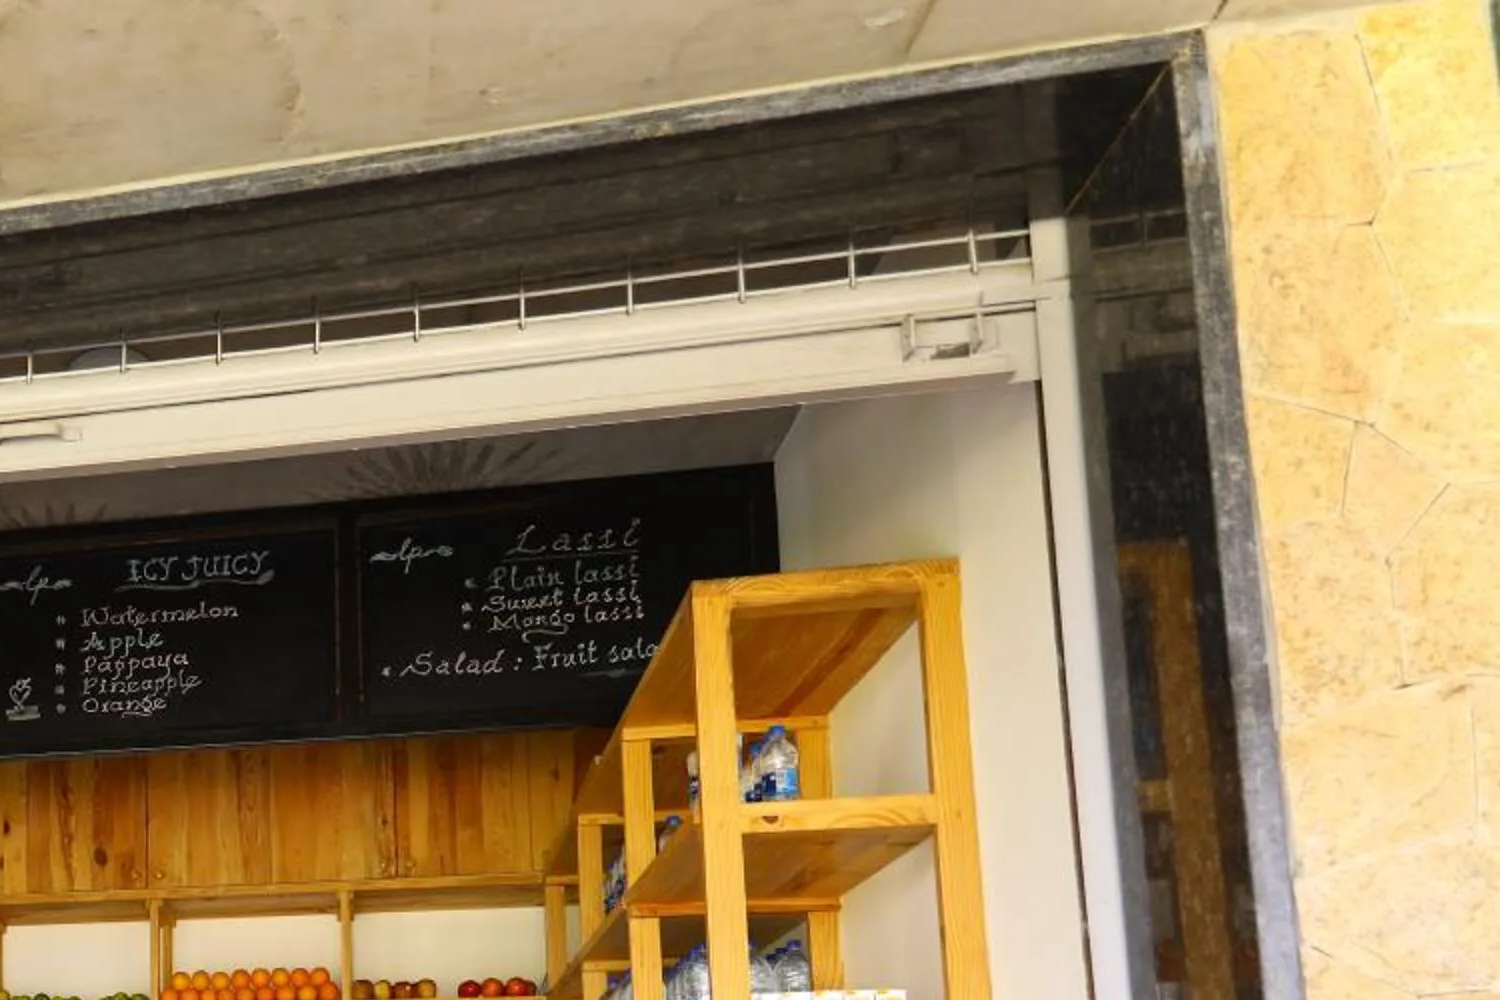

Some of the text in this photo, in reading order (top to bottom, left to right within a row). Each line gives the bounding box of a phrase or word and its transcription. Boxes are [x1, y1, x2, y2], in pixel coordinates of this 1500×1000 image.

[505, 518, 641, 554] Lassi
[126, 551, 269, 583] ICY JUICY
[484, 566, 565, 592] Plain
[80, 600, 239, 628] Watermelon
[482, 588, 564, 612] Sweet
[487, 608, 577, 643] Mango
[80, 628, 164, 660] Apple
[532, 639, 599, 671] Fruit
[607, 636, 659, 664] sala
[83, 652, 189, 680] Pappaya
[83, 669, 202, 697] Pineapple
[81, 695, 168, 718] Orange
